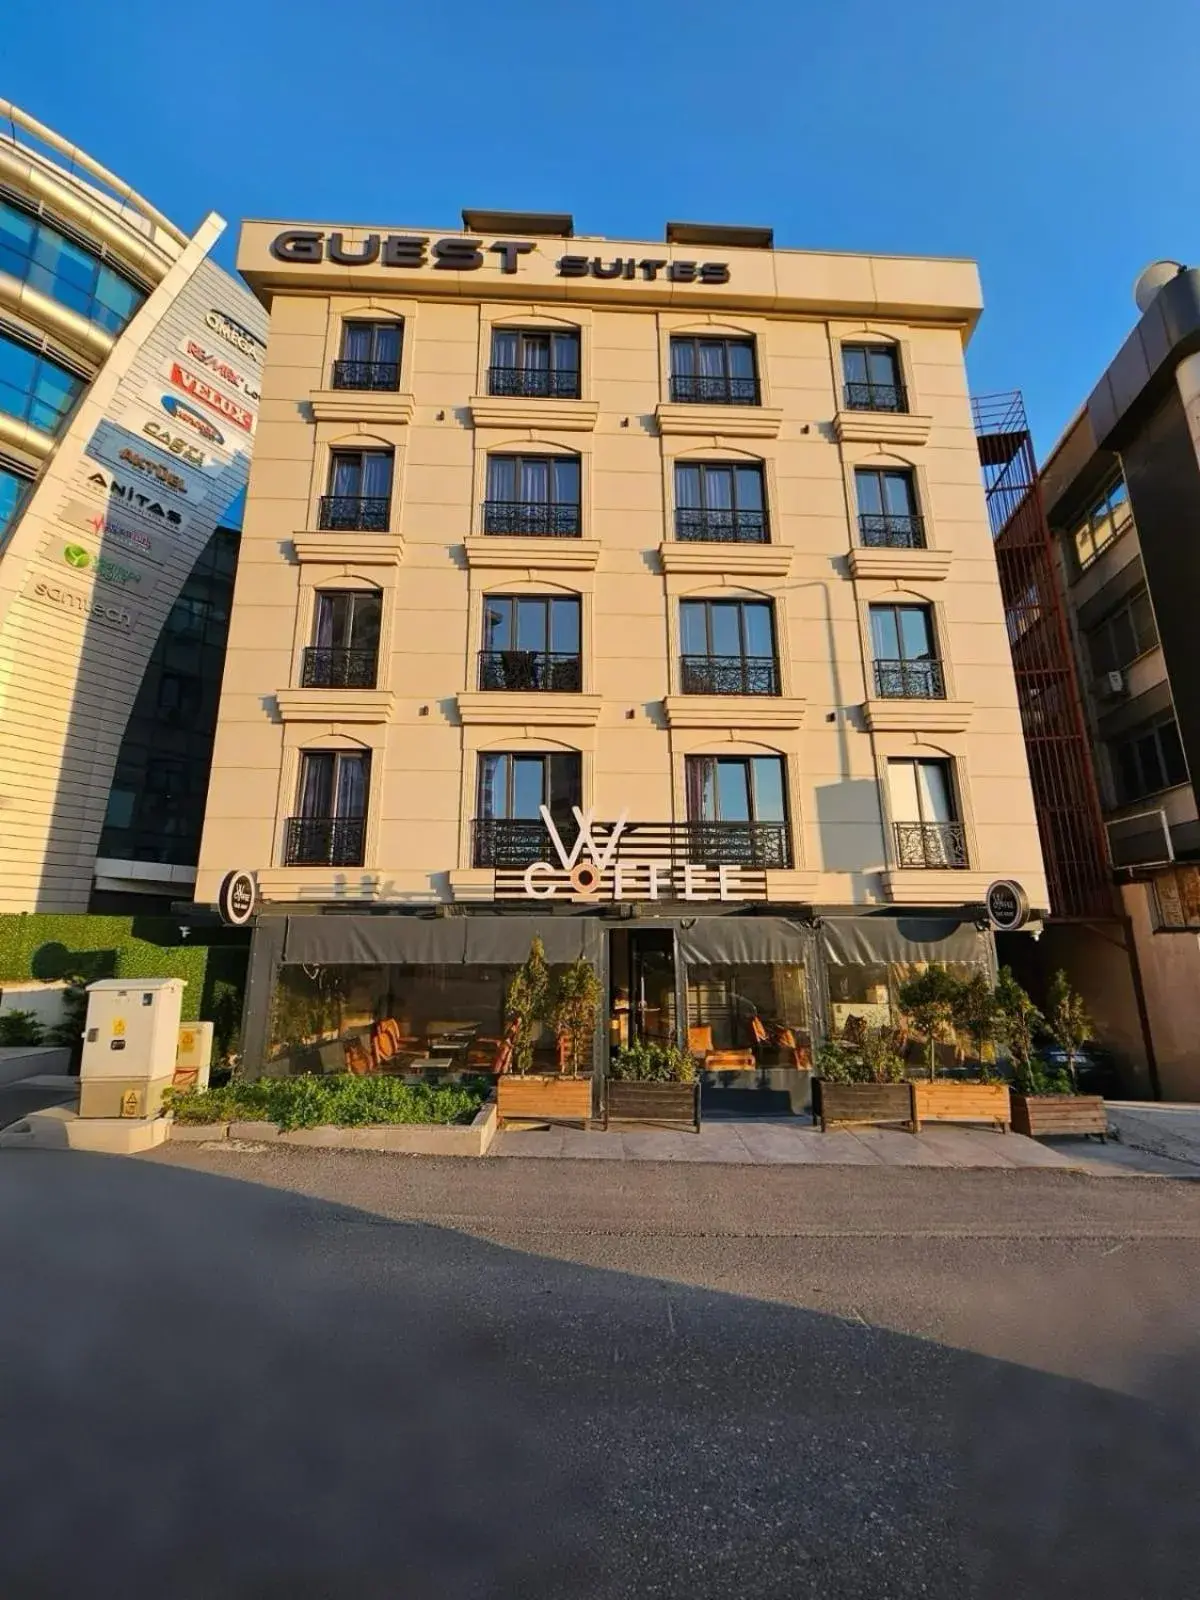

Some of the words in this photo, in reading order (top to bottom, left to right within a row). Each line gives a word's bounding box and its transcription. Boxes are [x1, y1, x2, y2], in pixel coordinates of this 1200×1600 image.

[269, 230, 537, 275] GUEST
[556, 255, 731, 285] SUITES
[205, 312, 257, 362] OMEGA
[179, 366, 246, 428] VELUX
[524, 861, 744, 900] COFFEE
